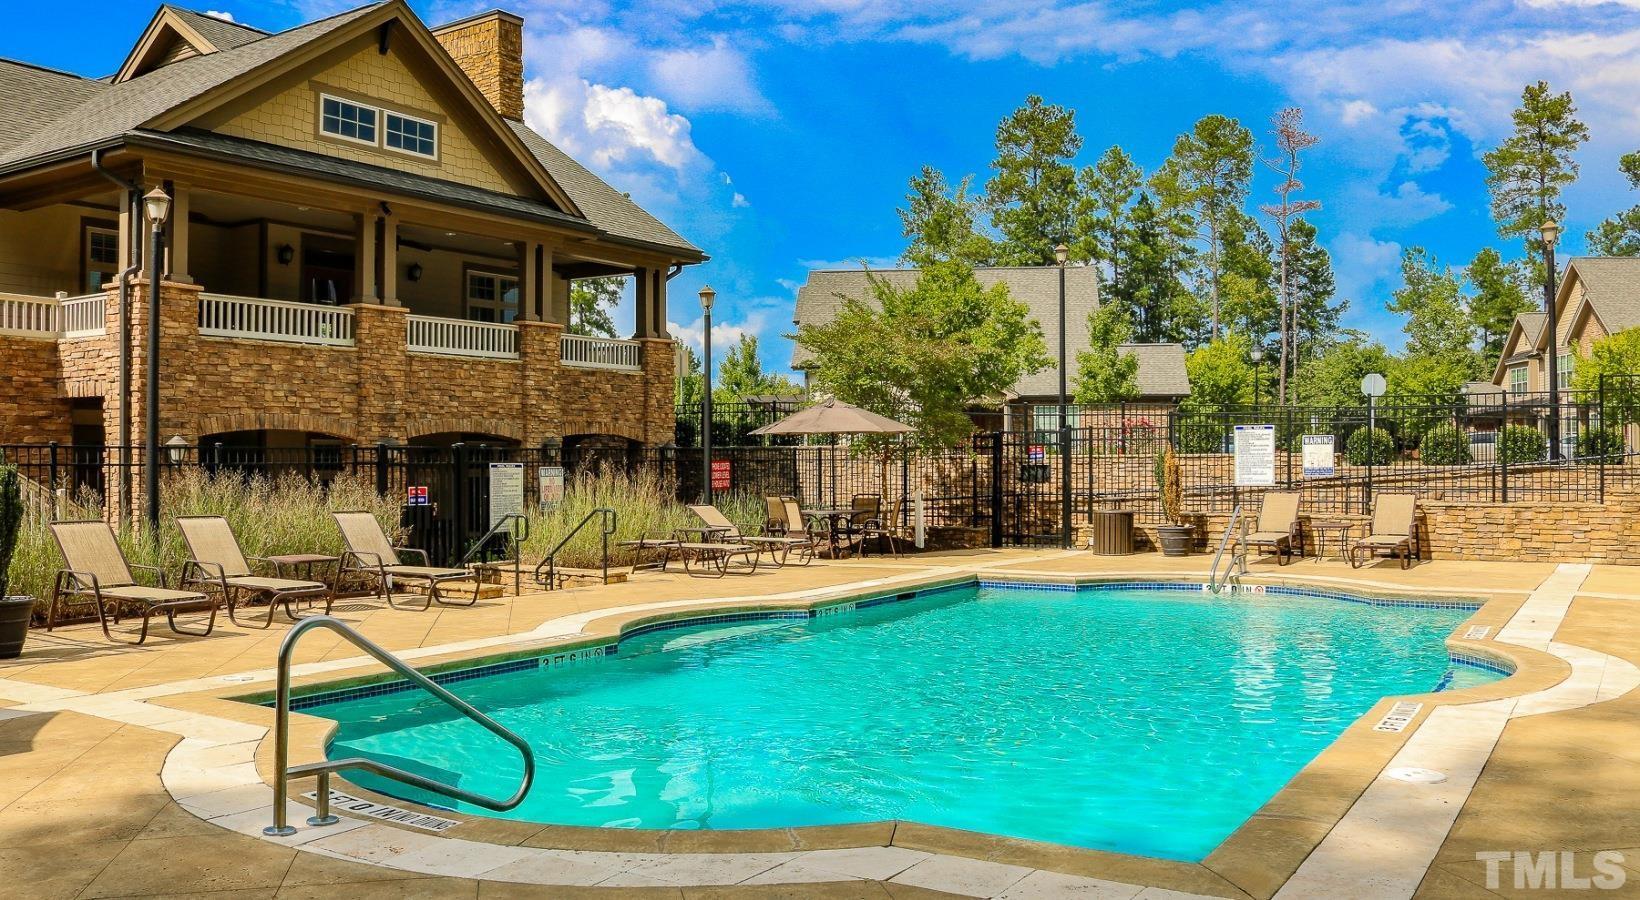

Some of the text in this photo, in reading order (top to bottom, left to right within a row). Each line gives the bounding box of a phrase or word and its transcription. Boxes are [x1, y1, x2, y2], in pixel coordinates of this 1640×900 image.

[1304, 436, 1334, 445] WARNING
[541, 468, 563, 477] WARNING
[554, 655, 565, 664] FT
[329, 795, 358, 805] FT
[368, 807, 403, 820] IN
